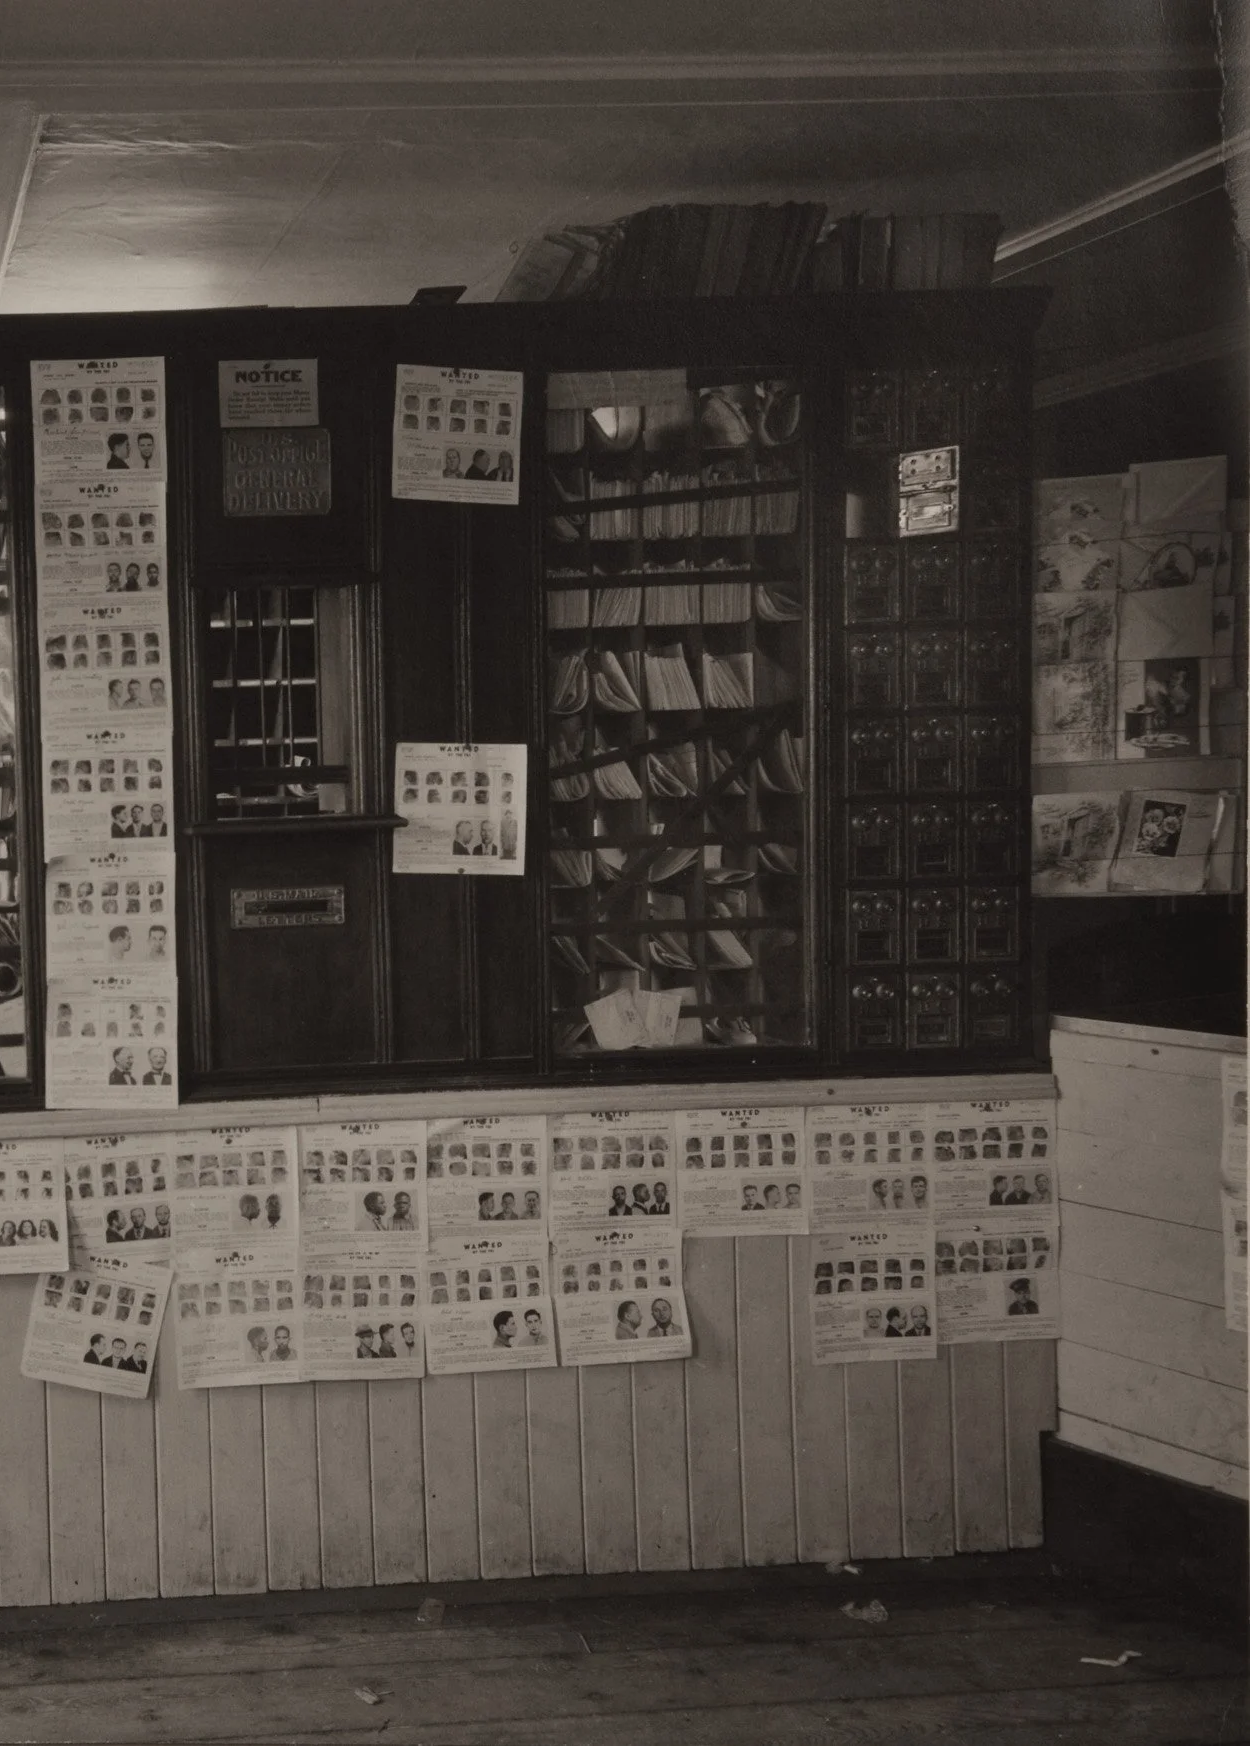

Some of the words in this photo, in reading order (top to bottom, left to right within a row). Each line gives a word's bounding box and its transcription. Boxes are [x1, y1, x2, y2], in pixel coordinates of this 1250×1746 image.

[77, 361, 119, 369] WTED
[235, 369, 302, 384] NOTICE
[228, 440, 264, 465] POST
[234, 468, 316, 490] GENERAL
[228, 490, 324, 511] DELIVERY
[81, 607, 122, 615] WATED
[720, 1109, 760, 1117] WANTED
[463, 1117, 500, 1126] WANED
[211, 1126, 251, 1134] WANTED
[340, 1123, 380, 1131] WATED
[849, 1233, 888, 1242] WANTED
[463, 1241, 503, 1250] WANED
[89, 1256, 129, 1268] WAND
